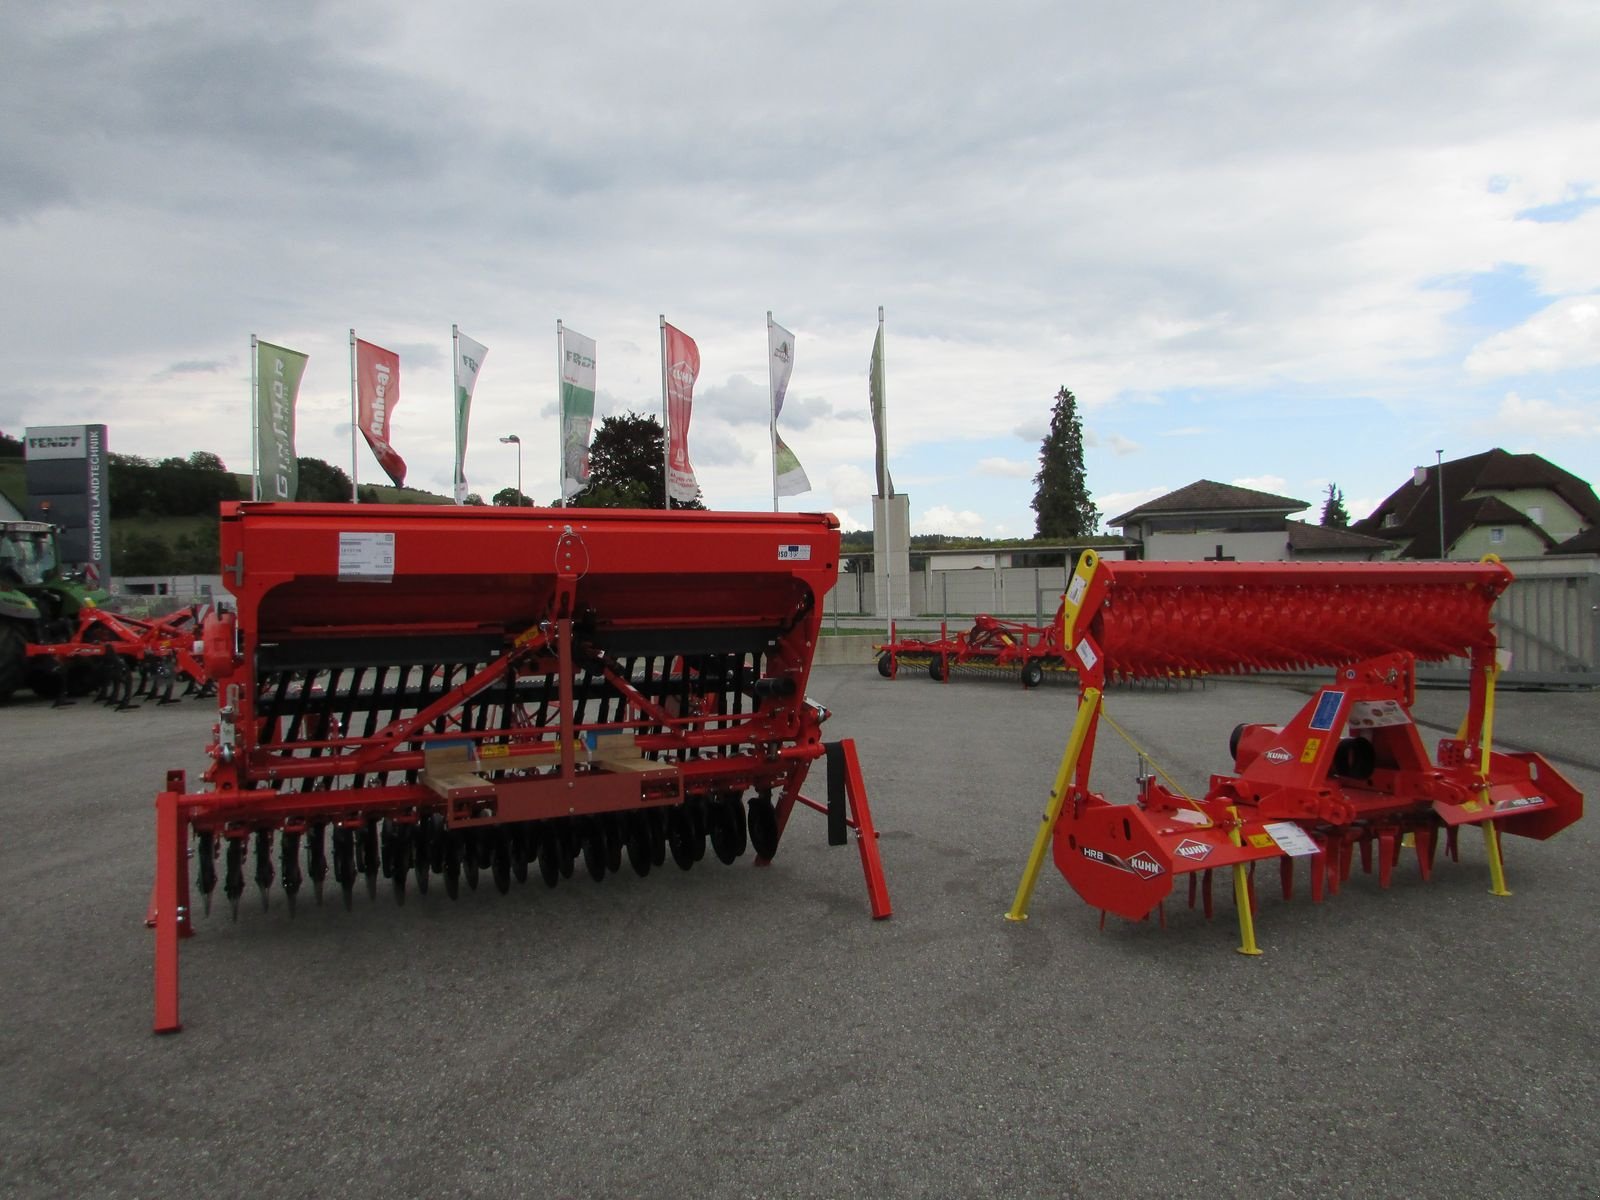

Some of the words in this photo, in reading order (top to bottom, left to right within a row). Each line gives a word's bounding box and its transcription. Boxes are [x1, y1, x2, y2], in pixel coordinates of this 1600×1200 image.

[89, 431, 101, 508] LANDTECHNIK
[1084, 848, 1104, 861] HRB
[1178, 844, 1208, 857] KUHN
[1131, 858, 1159, 873] KUHN
